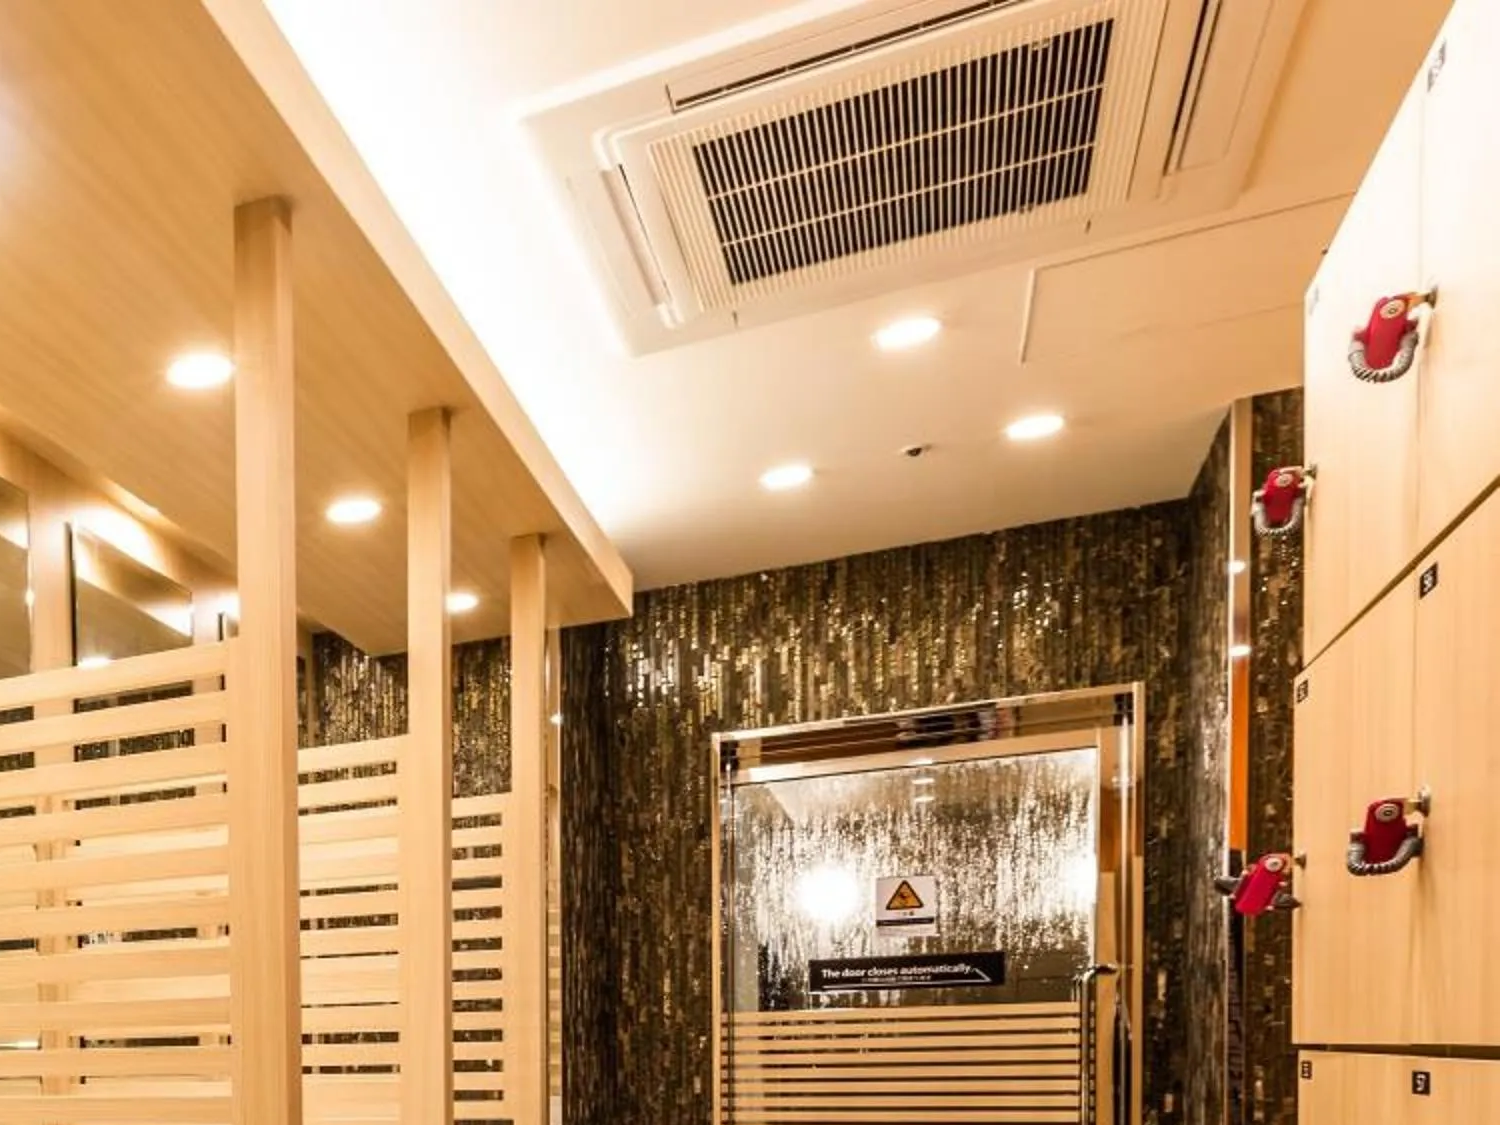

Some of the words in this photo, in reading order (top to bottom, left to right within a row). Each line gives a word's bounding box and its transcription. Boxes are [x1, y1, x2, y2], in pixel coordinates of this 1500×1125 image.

[821, 969, 840, 979] The
[842, 967, 865, 977] door
[867, 966, 899, 977] closes
